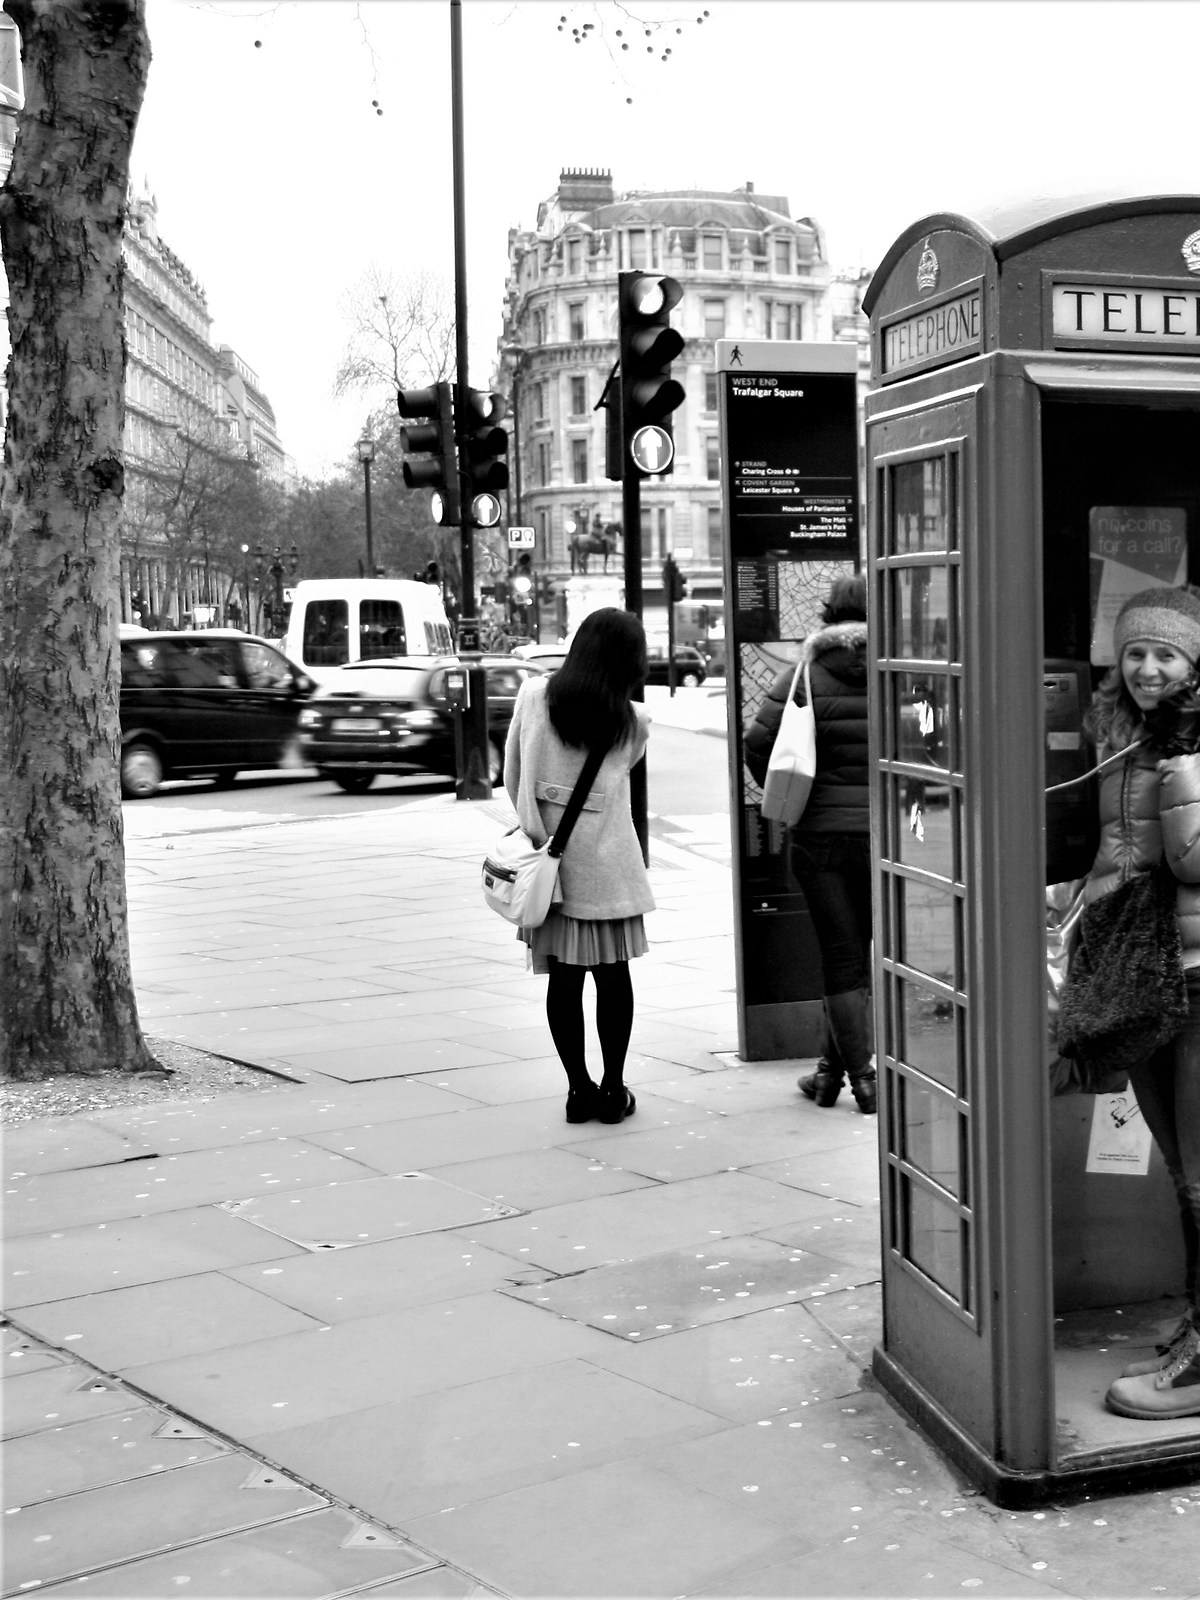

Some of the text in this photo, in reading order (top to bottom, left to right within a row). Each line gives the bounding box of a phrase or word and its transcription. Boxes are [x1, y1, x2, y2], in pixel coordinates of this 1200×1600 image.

[888, 297, 980, 366] TELEPHONE
[732, 378, 778, 386] WEST END
[732, 387, 804, 398] Trafalgar Square
[742, 468, 766, 476] Charing
[1125, 517, 1172, 533] coins
[1098, 535, 1182, 553] for a call?
